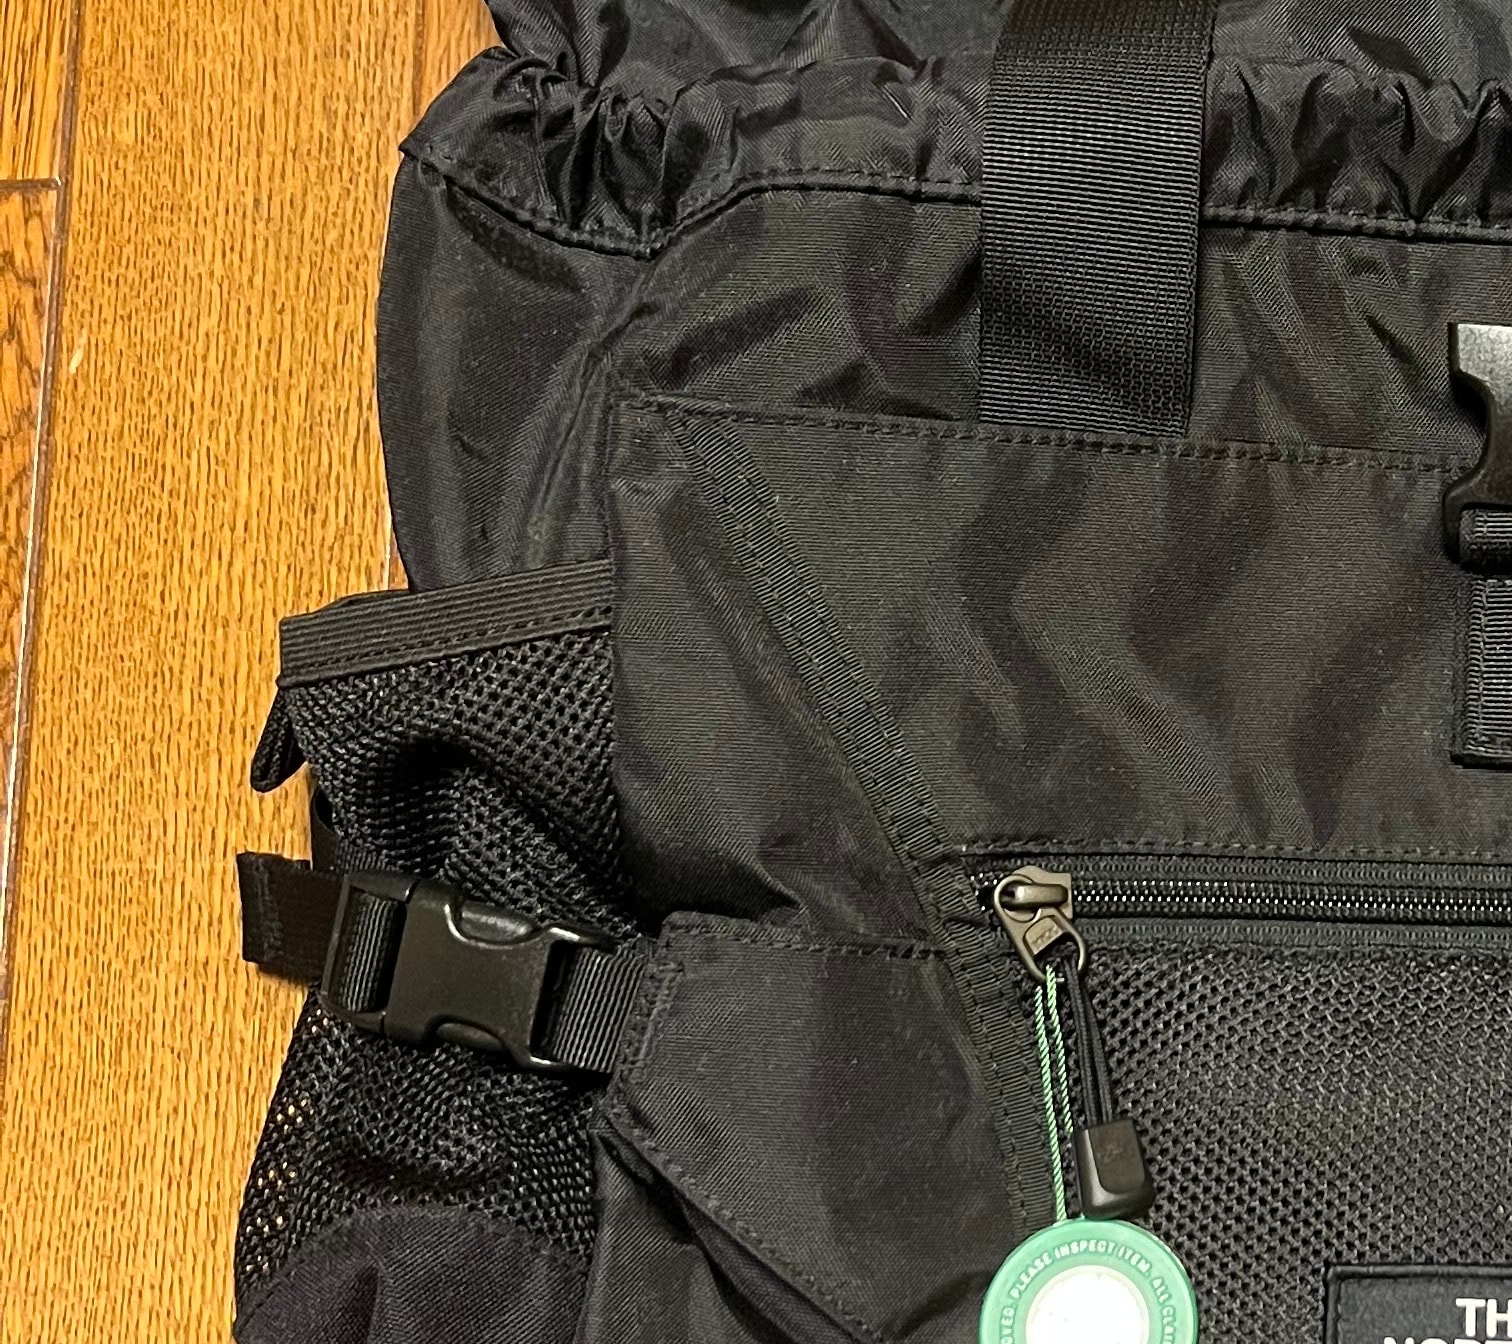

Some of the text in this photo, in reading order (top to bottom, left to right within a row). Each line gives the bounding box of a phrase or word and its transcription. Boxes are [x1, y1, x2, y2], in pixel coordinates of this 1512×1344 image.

[1009, 1252, 1053, 1299] PLEASE
[1054, 1239, 1116, 1259] INSPECT
[1151, 1276, 1170, 1304] ALL
